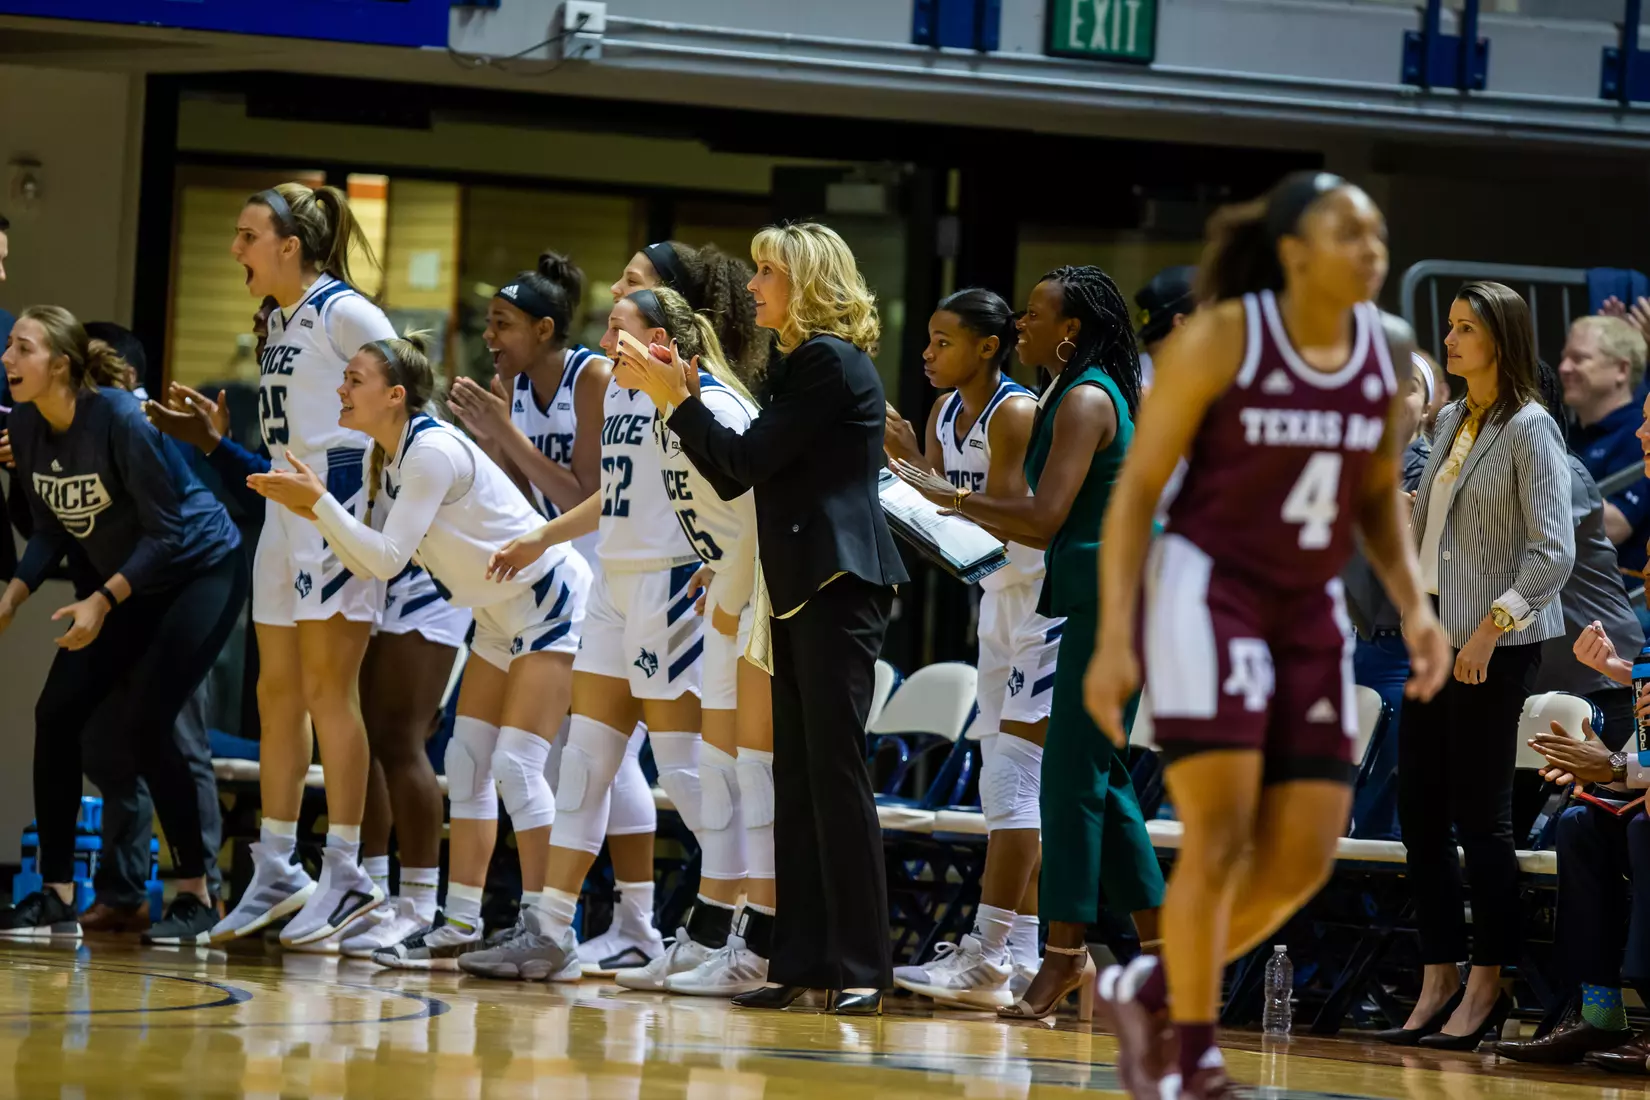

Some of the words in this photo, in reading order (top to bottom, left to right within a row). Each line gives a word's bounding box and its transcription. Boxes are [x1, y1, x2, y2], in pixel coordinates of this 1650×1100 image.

[1068, 0, 1141, 52] EXIT
[1240, 407, 1343, 447] TEXAS
[38, 478, 101, 510] RICE
[601, 456, 633, 517] 22
[1280, 452, 1342, 549] 4
